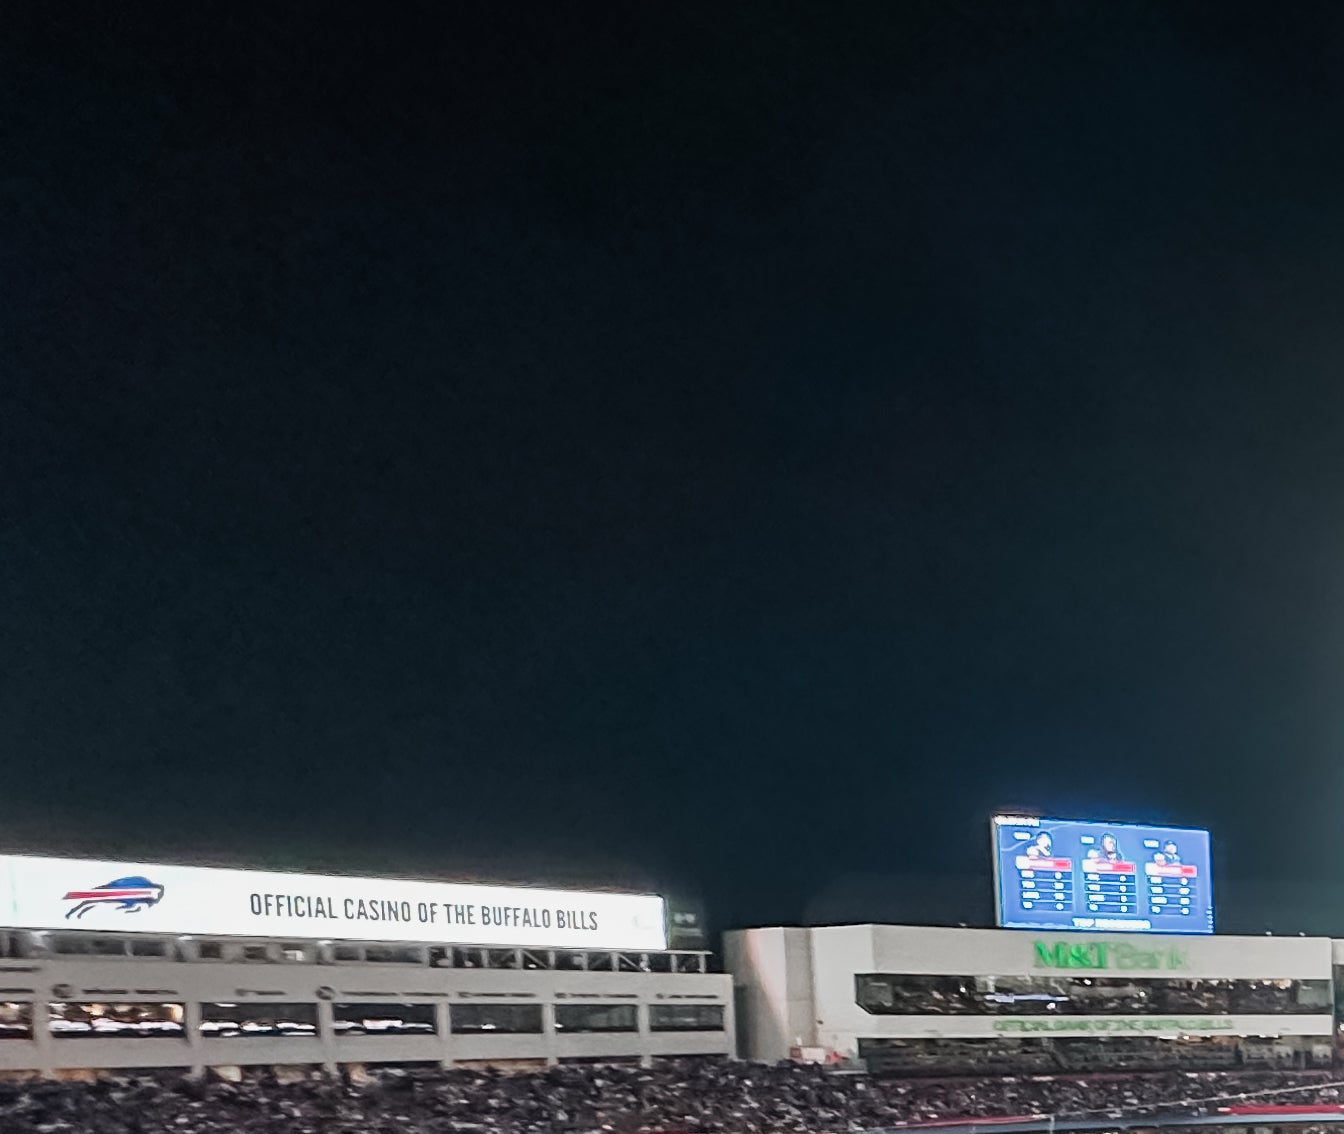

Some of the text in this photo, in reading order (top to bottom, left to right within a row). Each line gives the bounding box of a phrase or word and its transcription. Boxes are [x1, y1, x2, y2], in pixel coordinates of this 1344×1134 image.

[250, 893, 598, 931] OFFICIAL CASINO OF THE BUFFALO BILLS
[1033, 940, 1107, 969] M&T
